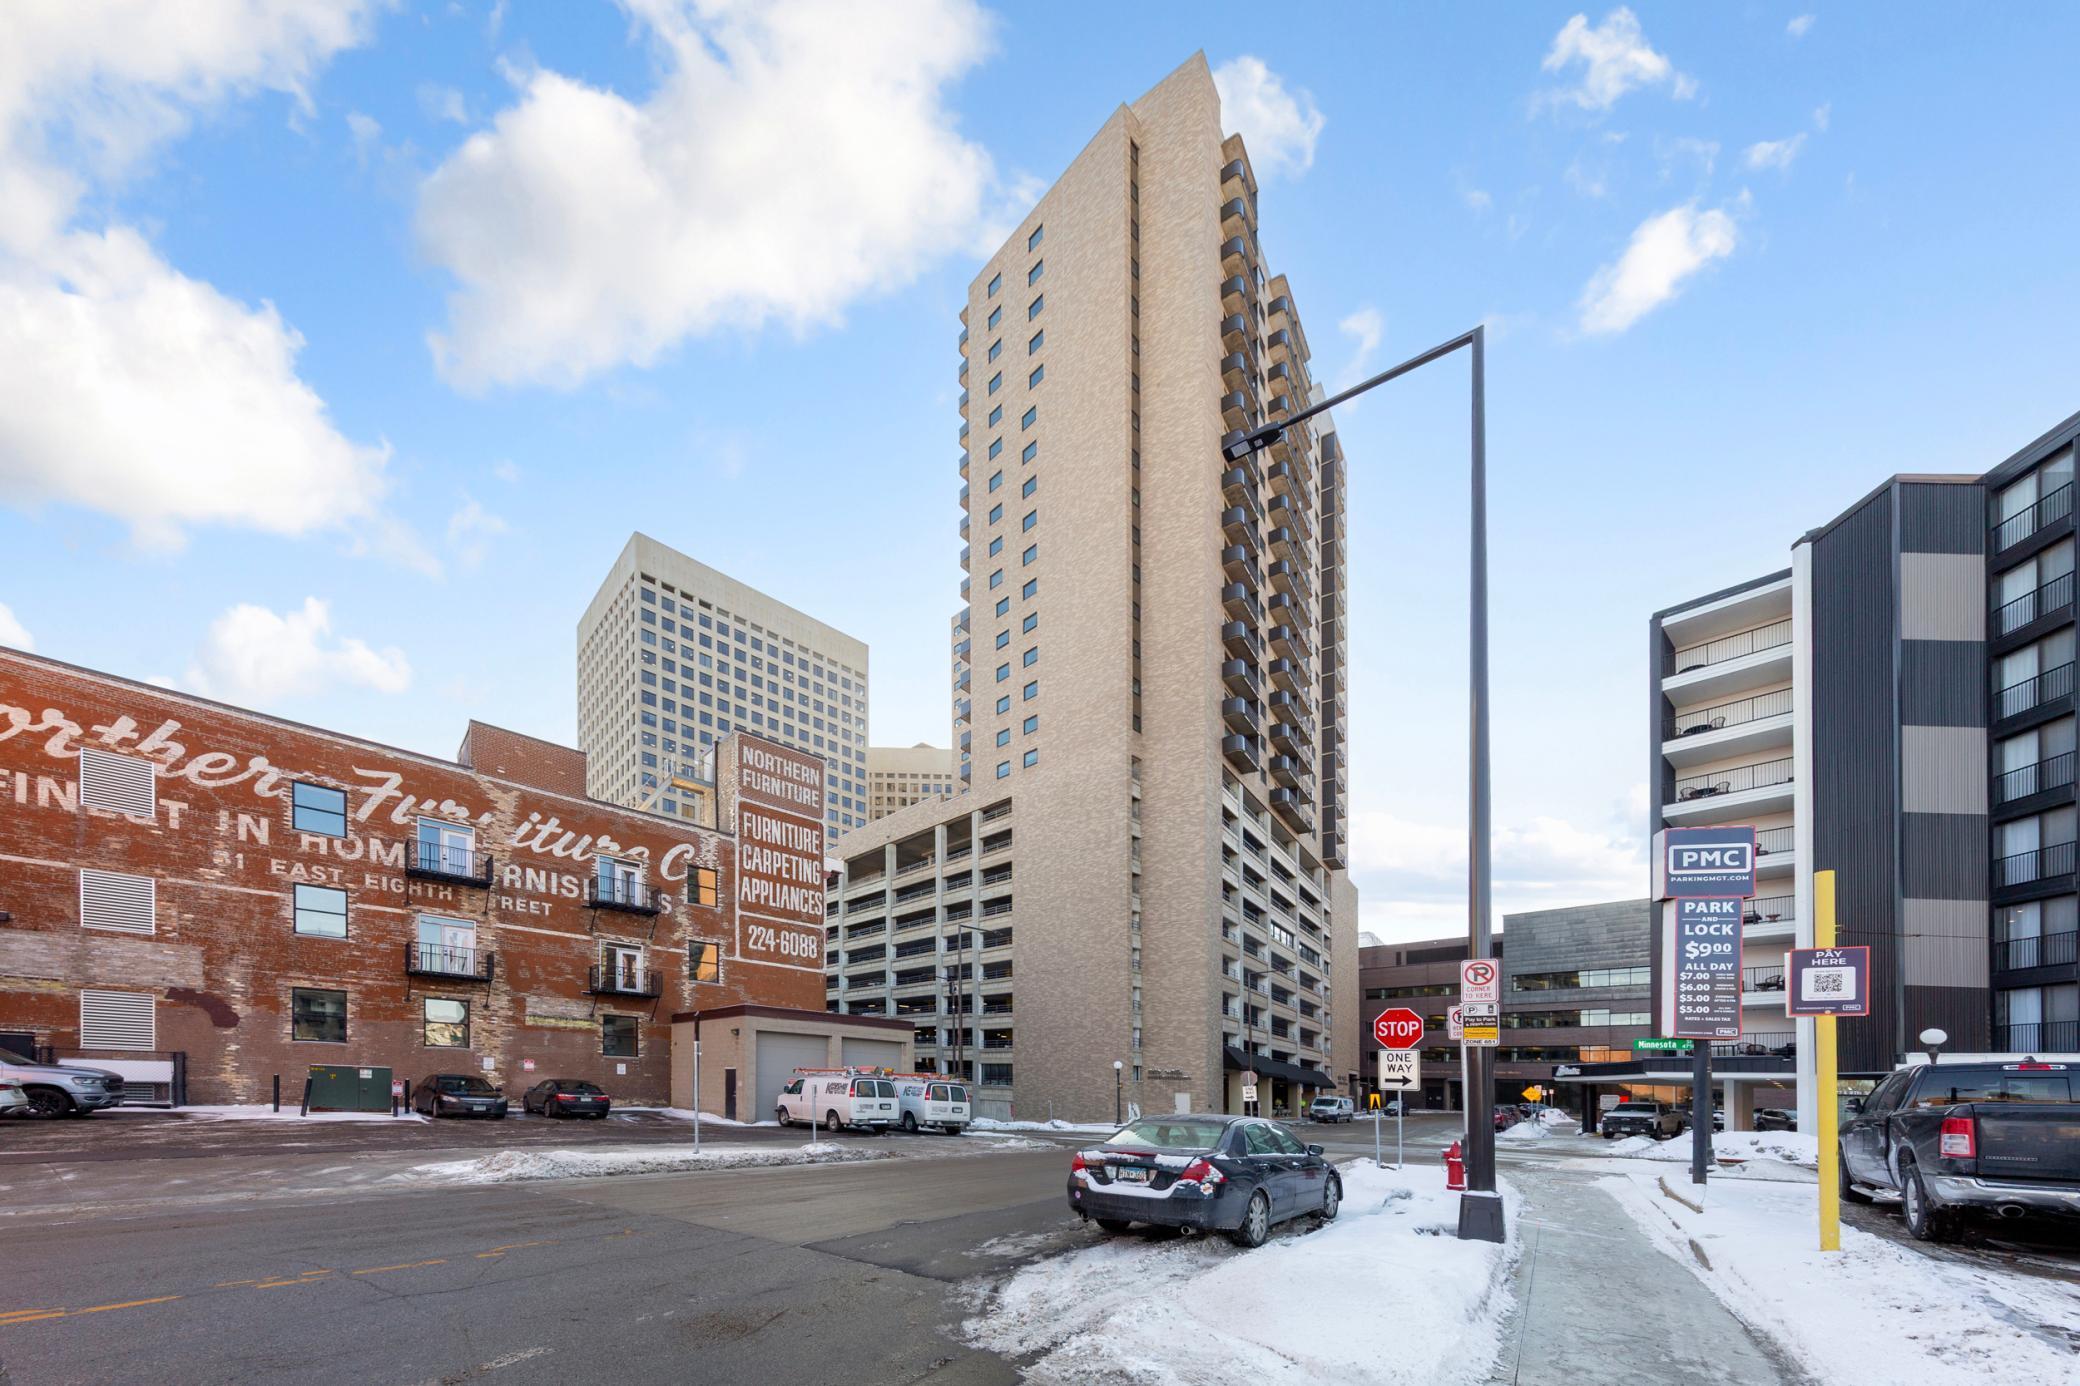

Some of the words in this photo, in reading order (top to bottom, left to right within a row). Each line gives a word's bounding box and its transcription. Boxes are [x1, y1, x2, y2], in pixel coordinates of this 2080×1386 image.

[743, 746, 820, 785] NORTHERN
[743, 769, 819, 808] FURNITURE
[217, 810, 269, 845] IN
[743, 812, 820, 855] FURNITURE
[1682, 850, 1741, 867] PMC
[743, 844, 821, 886] CARPETING
[271, 858, 344, 882] EAST
[365, 873, 453, 900] EIGHTH
[741, 876, 823, 916] APPLIANCES
[1684, 901, 1735, 913] PARK
[1684, 924, 1734, 936] LOCK
[748, 924, 817, 959] 224-6088
[1815, 950, 1843, 958] PAY
[1685, 962, 1707, 971] ALL
[1710, 962, 1734, 971] DAY
[1811, 958, 1847, 966] HERE
[1680, 971, 1710, 981] $7.00
[1680, 982, 1711, 992] $6.00
[1680, 993, 1710, 1003] $5.00
[1680, 1004, 1710, 1014] $5.00
[1378, 1020, 1420, 1037] STOP
[1638, 1040, 1677, 1050] Minnesota
[1386, 1053, 1411, 1063] ONE
[1387, 1064, 1413, 1073] WAY
